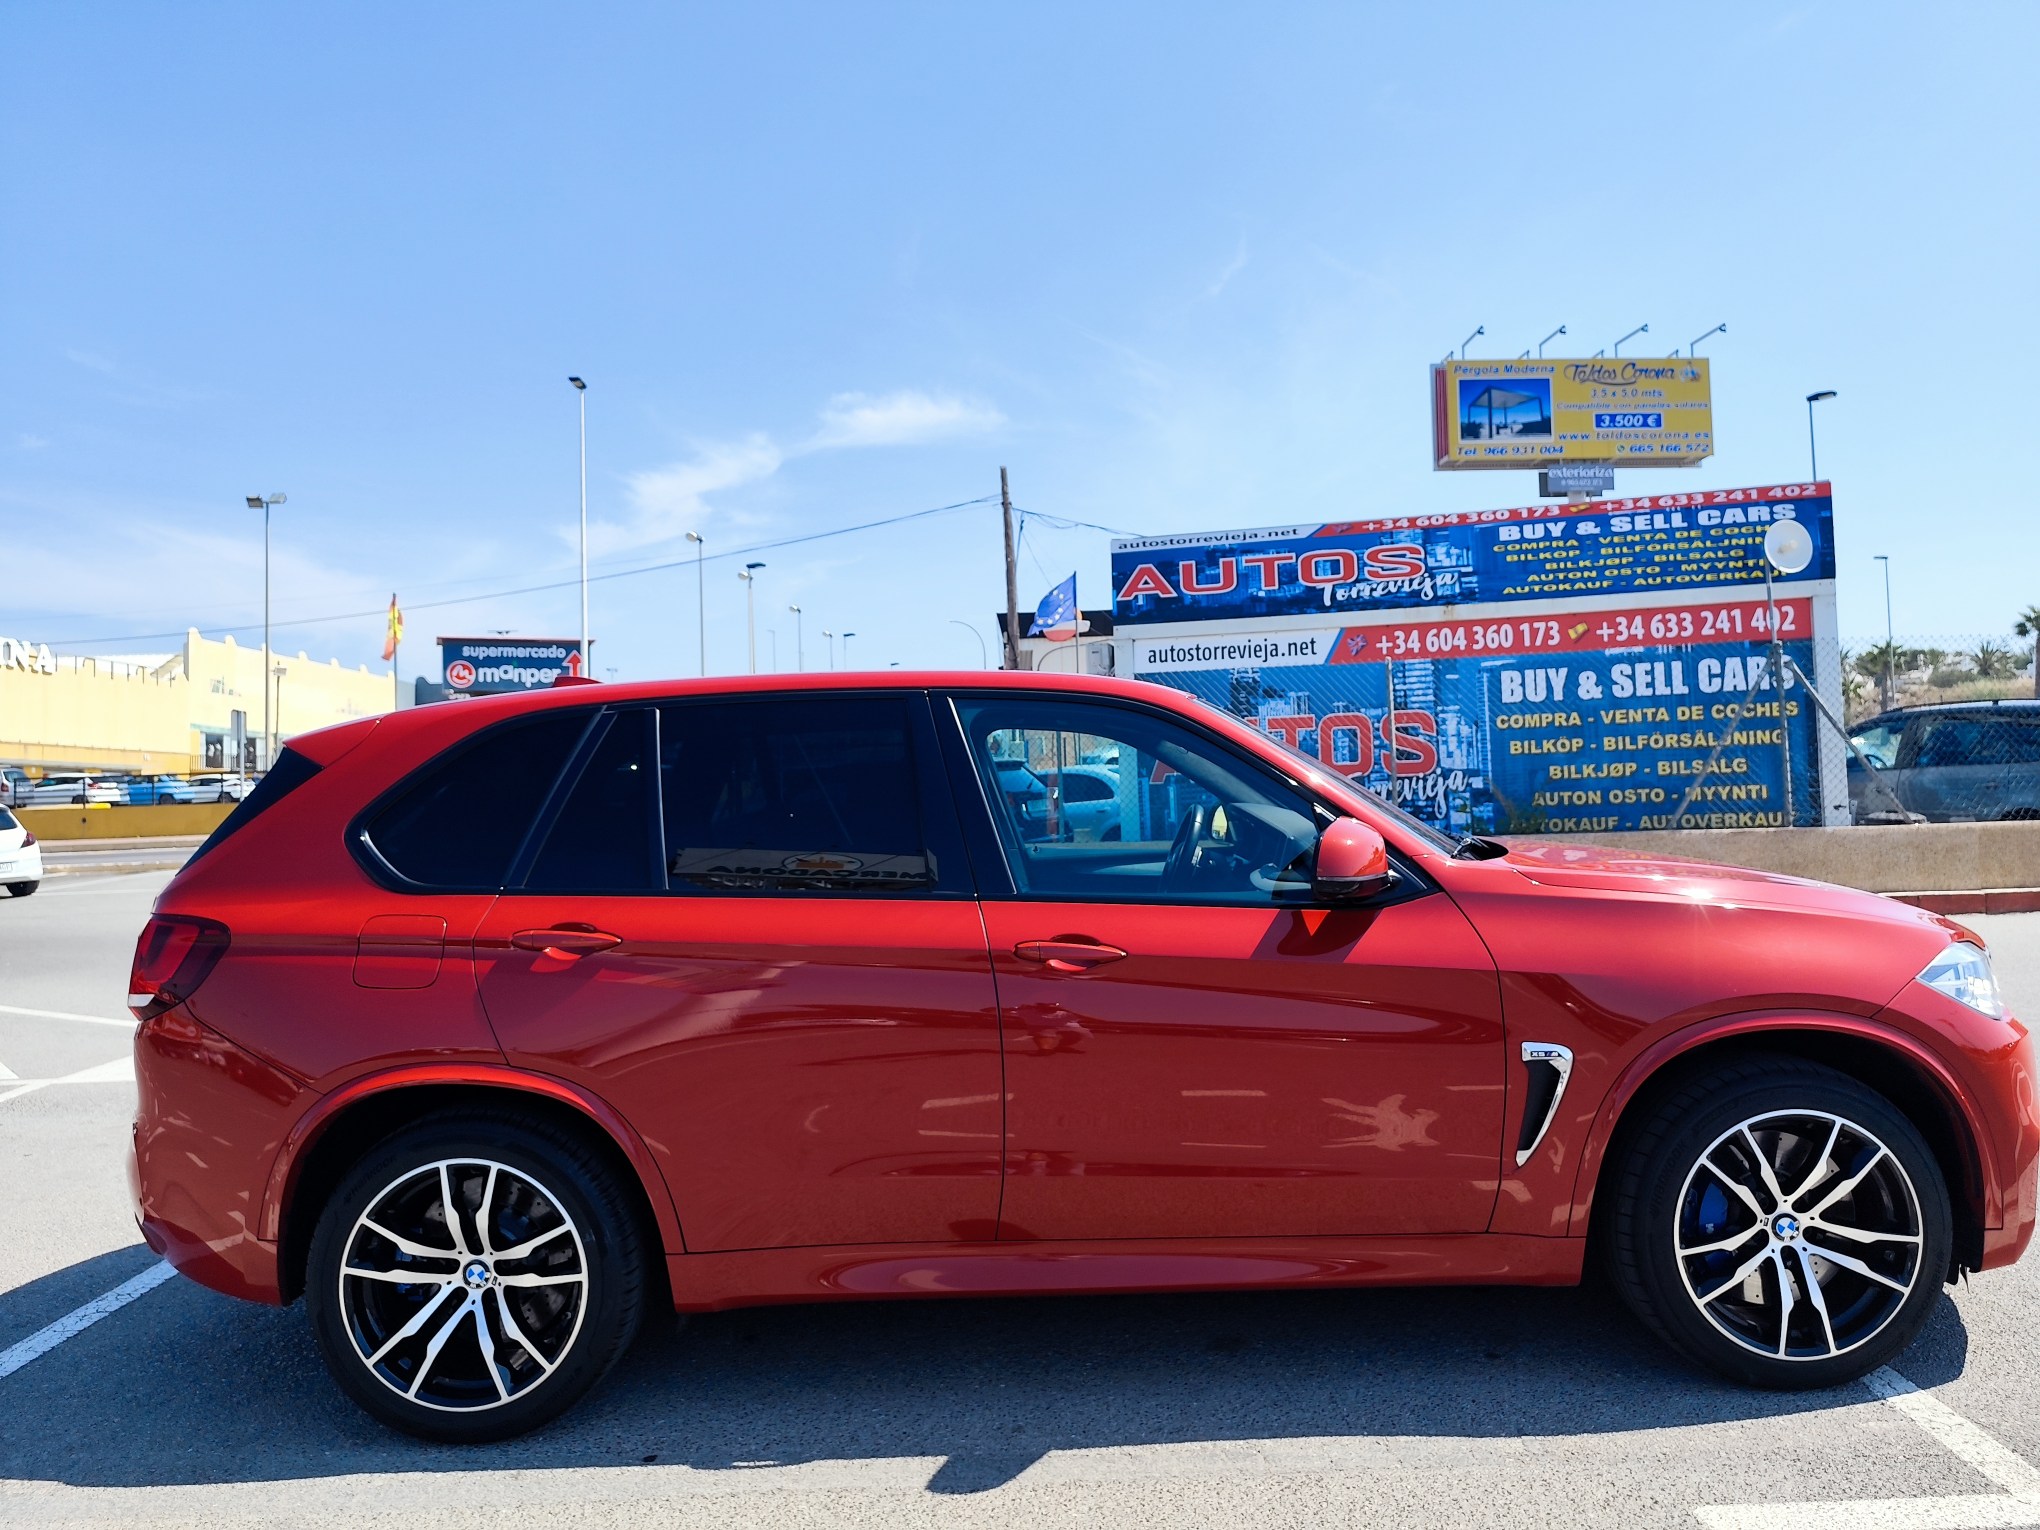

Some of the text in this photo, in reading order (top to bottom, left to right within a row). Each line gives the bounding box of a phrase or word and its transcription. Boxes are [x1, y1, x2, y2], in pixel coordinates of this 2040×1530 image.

[1453, 364, 1555, 375] Pergola Moderna
[1563, 362, 1675, 383] Toldos Corona
[1600, 415, 1658, 427] 3.500 €
[1629, 443, 1709, 453] 665 166 572
[1362, 484, 1817, 531] +34 604 360 173 +34 633 241 402
[1498, 503, 1797, 542] BUY & SELL CARS
[1118, 528, 1299, 550] autostorrevieja.net
[1492, 539, 1579, 553] COMPRA
[1598, 531, 1668, 545] VENTA
[1675, 529, 1703, 539] DE
[1709, 524, 1770, 536] COCH
[1654, 549, 1745, 563] BILSALG
[1116, 545, 1425, 601] AUTOS
[1527, 570, 1597, 582] AUTON
[1604, 565, 1661, 577] OSTO
[1681, 558, 1764, 572] MYYNTI
[1316, 572, 1459, 606] Torrevieja
[1502, 580, 1613, 595] AUTOKAUF
[1376, 605, 1796, 655] +34 604 360 173 +34 633 241 402
[462, 645, 567, 660] supermercado
[1148, 637, 1317, 663] autostorrevieja.net
[477, 664, 562, 688] manper
[1501, 654, 1795, 704] BUY & SELL CARS
[1495, 711, 1582, 729] COMPRA
[1600, 706, 1670, 725] VENTA
[1676, 704, 1704, 722] DE
[1711, 700, 1800, 720] COCHES
[1509, 735, 1584, 755] BILKÖP
[1549, 762, 1637, 780] BILKJØP
[1656, 757, 1748, 776] BILSALG
[1532, 790, 1602, 807] AUTON
[1608, 787, 1665, 804] OSTO
[1685, 784, 1768, 801] MYYNTI
